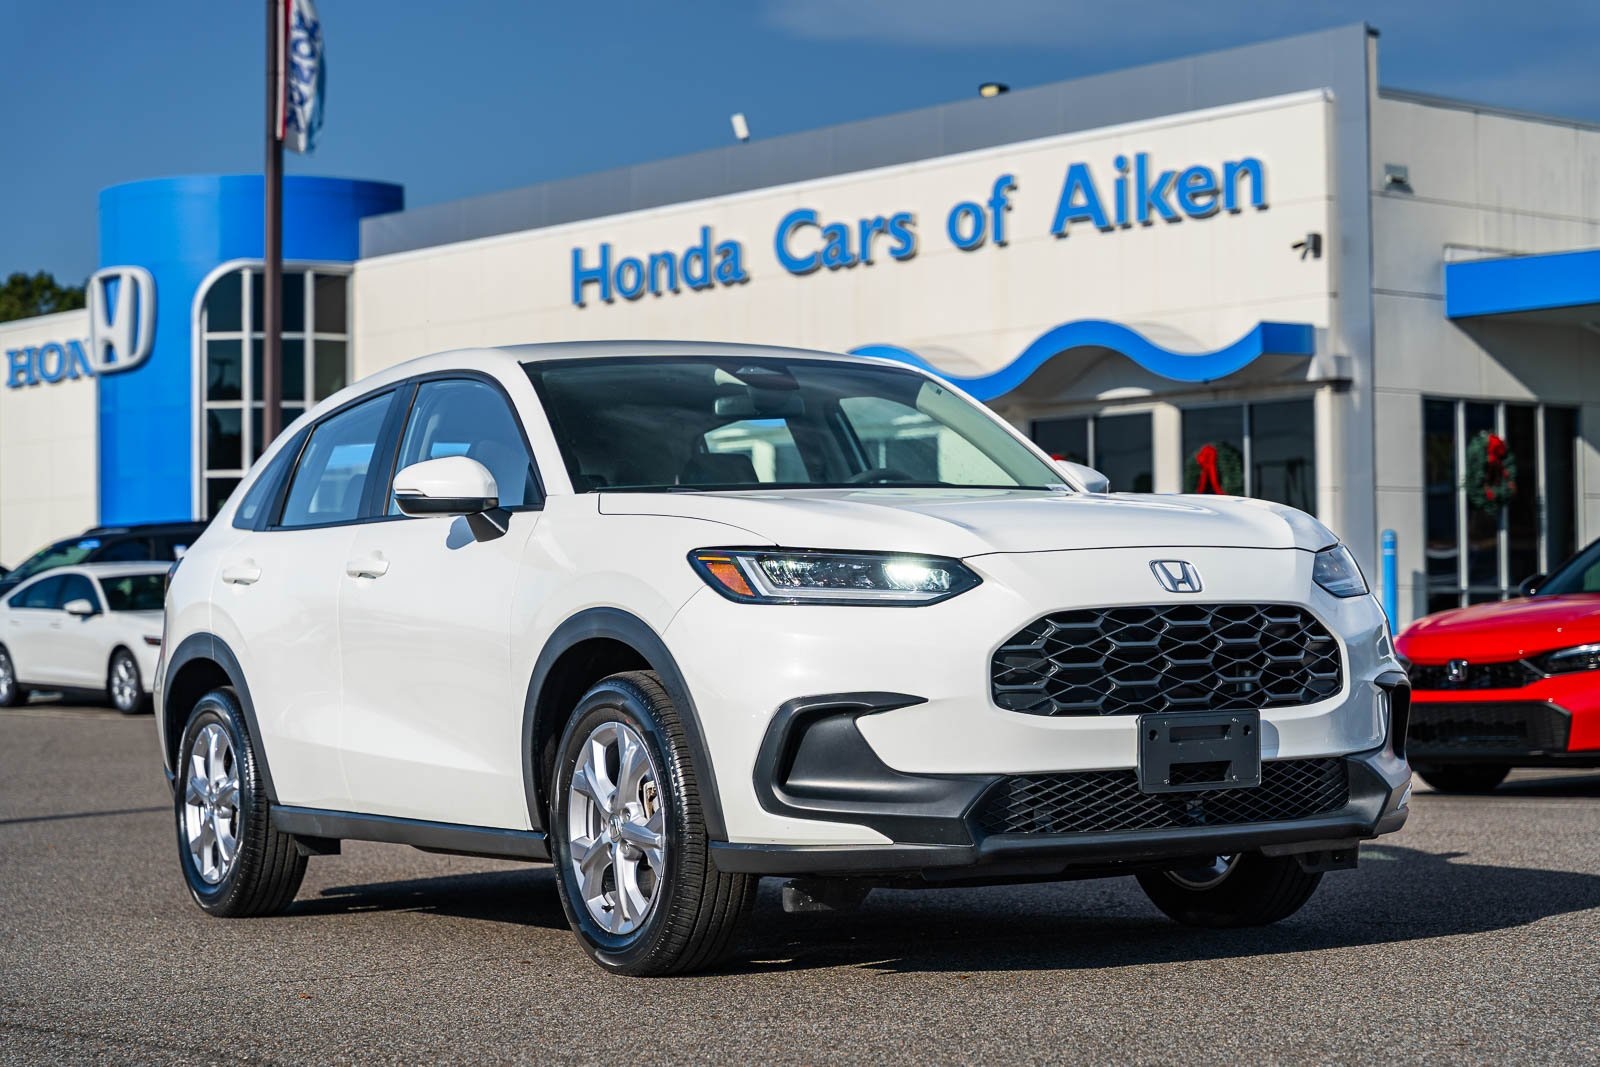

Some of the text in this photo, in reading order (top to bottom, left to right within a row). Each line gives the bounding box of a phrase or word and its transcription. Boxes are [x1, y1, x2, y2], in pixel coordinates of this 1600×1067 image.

[571, 152, 1269, 307] Honda Cars of Aiken
